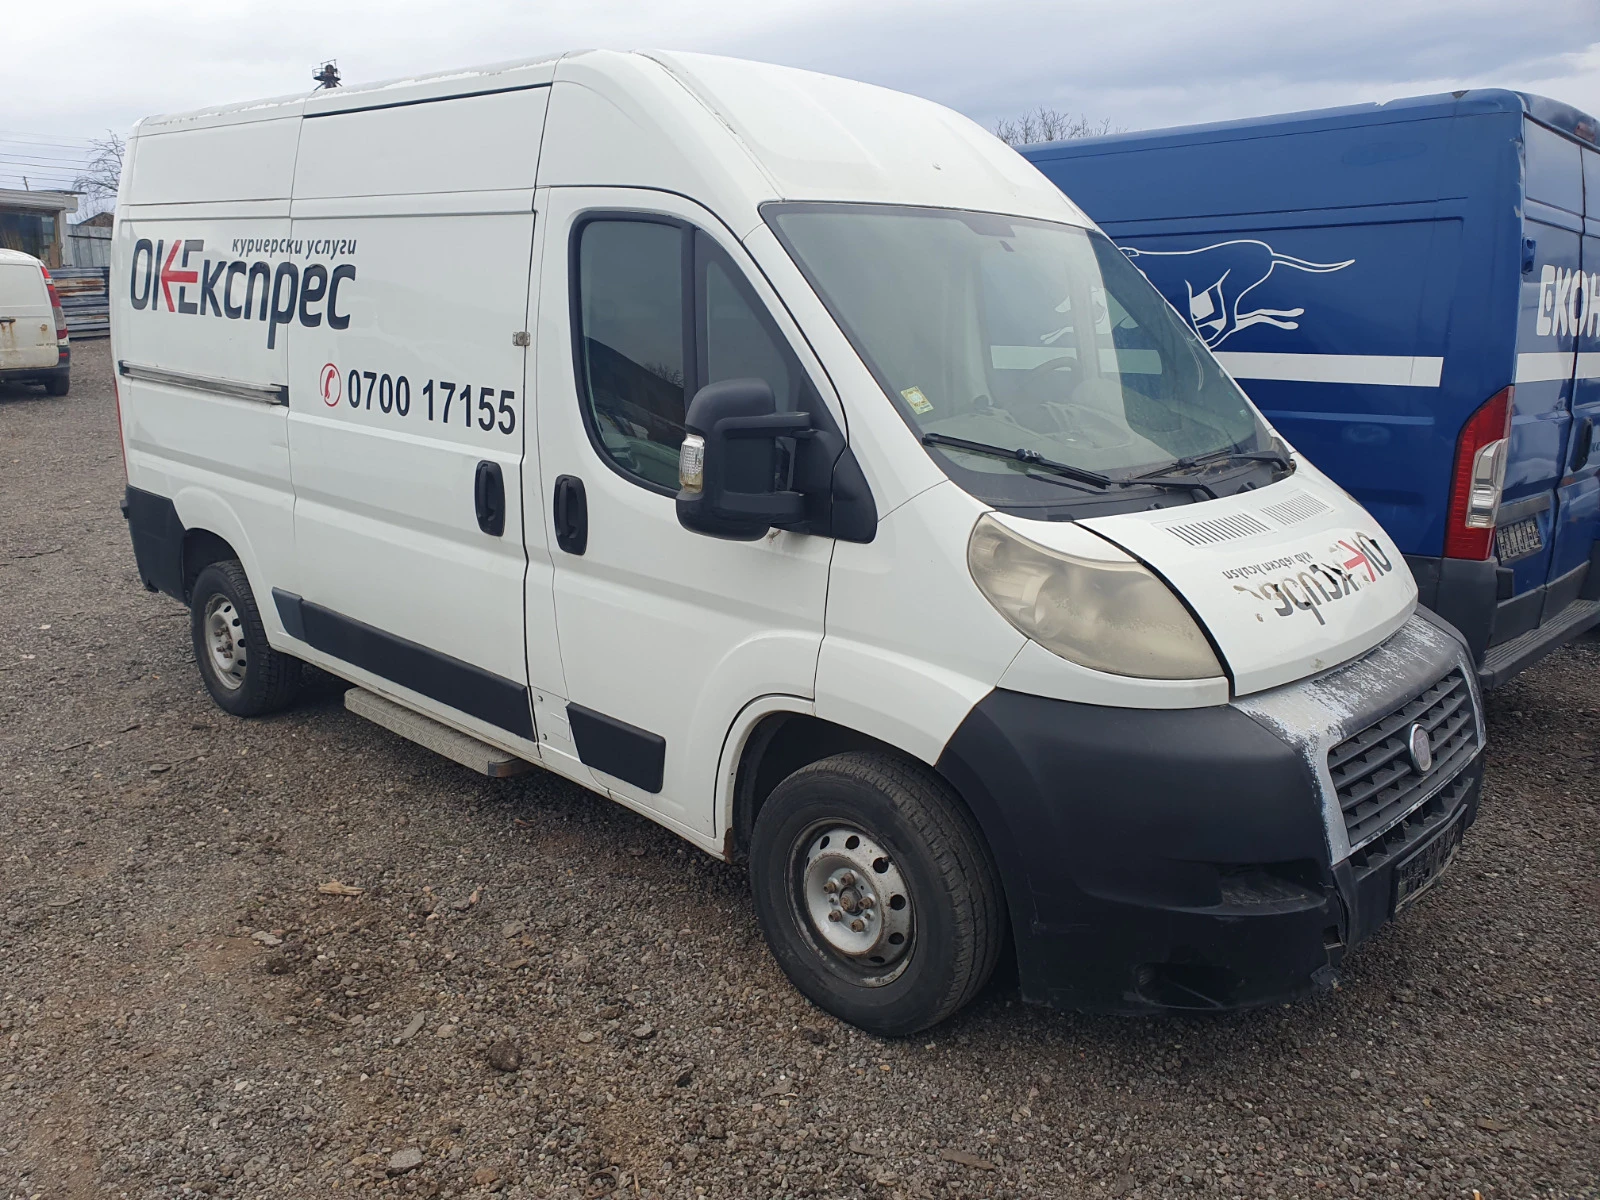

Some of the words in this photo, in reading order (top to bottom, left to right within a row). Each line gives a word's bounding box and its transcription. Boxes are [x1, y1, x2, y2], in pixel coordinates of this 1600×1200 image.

[231, 237, 302, 258] куриерски
[305, 239, 357, 258] услуги
[347, 369, 411, 417] 0700
[422, 379, 517, 435] 17155
